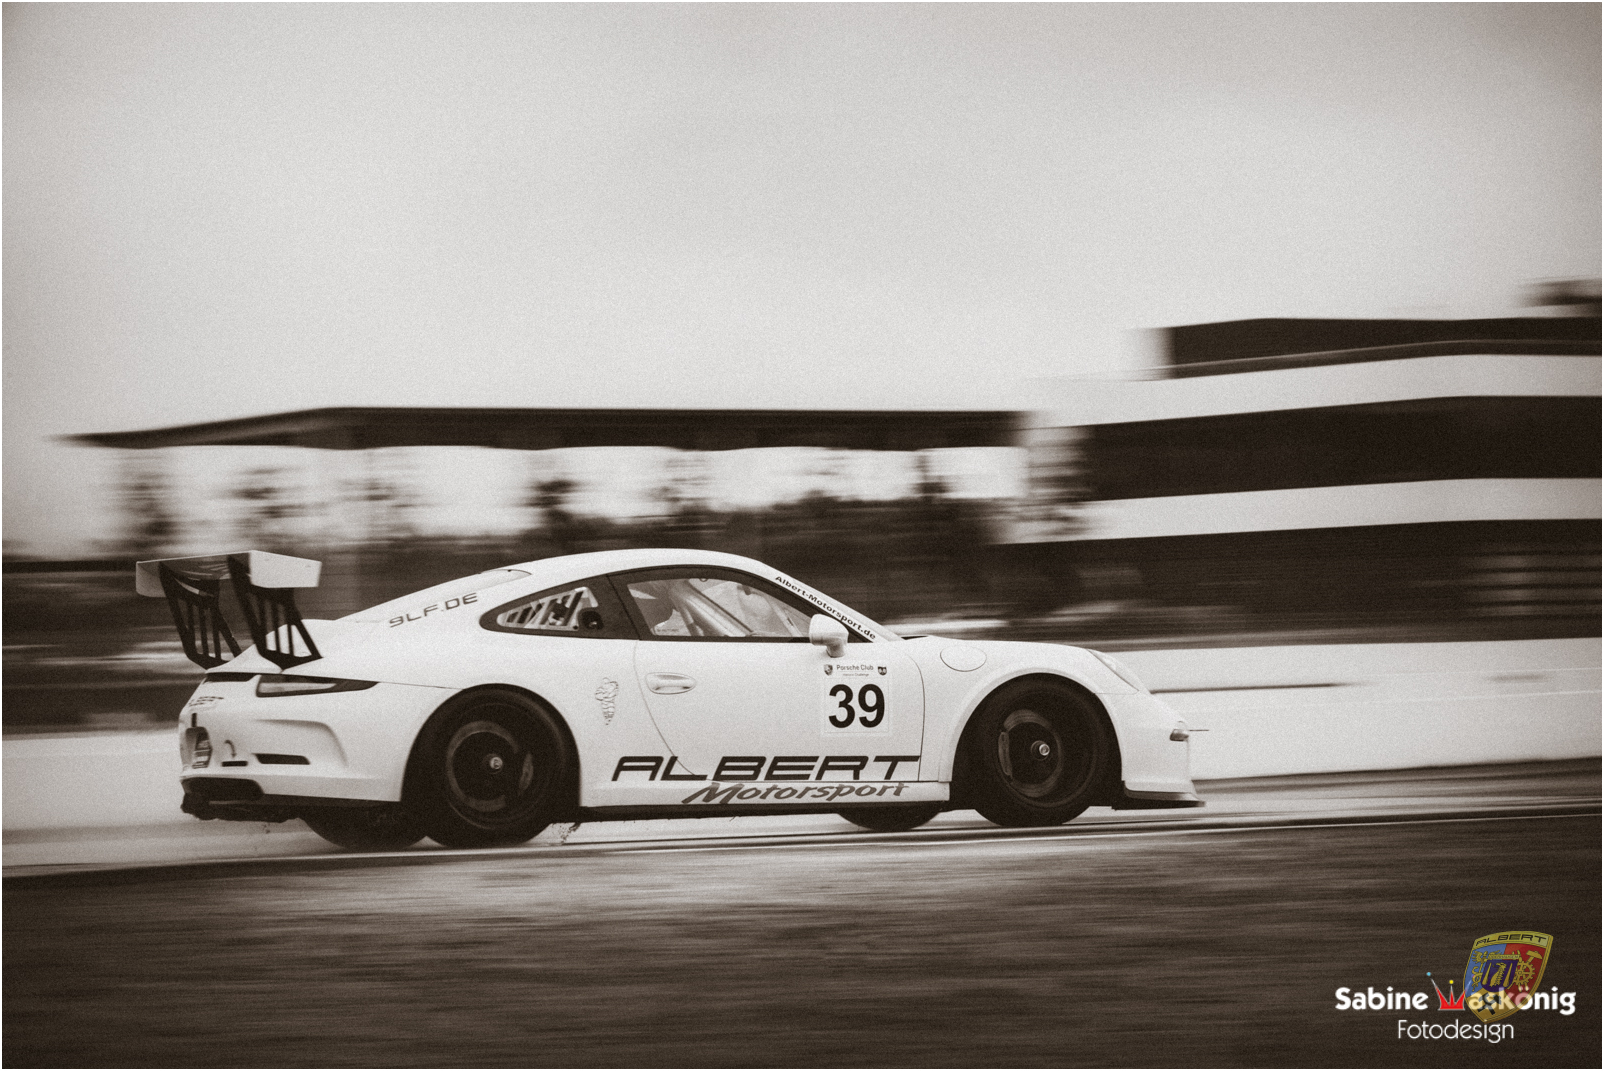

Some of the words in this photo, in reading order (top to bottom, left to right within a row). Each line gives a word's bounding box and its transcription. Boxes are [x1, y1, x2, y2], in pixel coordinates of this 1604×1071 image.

[775, 575, 876, 640] Albert-Motorsport.de
[828, 683, 885, 729] 39
[611, 755, 921, 782] ALBERT
[681, 782, 909, 804] Motorsport
